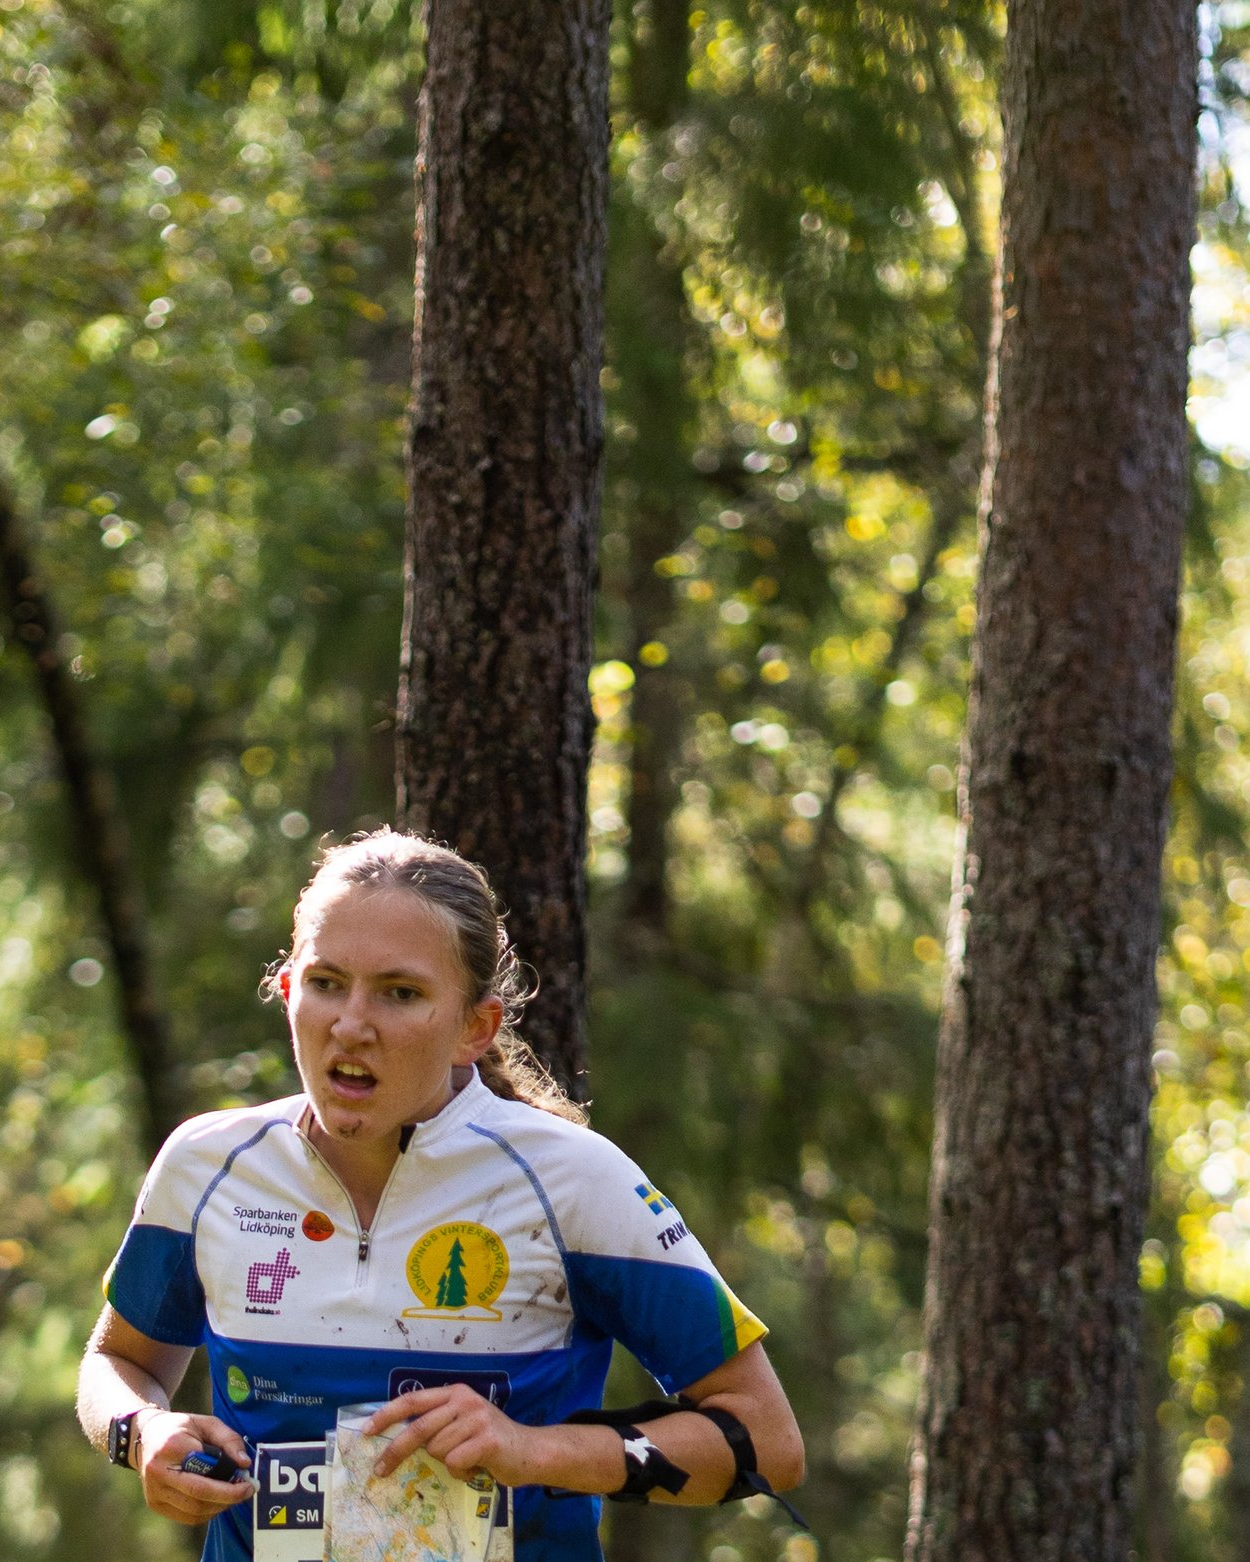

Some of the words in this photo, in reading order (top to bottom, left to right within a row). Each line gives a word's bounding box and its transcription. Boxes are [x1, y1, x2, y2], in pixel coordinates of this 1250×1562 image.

[233, 1206, 298, 1222] Sparbanken
[240, 1220, 296, 1239] Lidköping
[657, 1220, 690, 1251] TRIM
[440, 1225, 505, 1302] VINTERSPORTKLUBB
[253, 1375, 278, 1389] Dina
[254, 1389, 324, 1406] Försäkringar
[296, 1509, 319, 1523] SM
